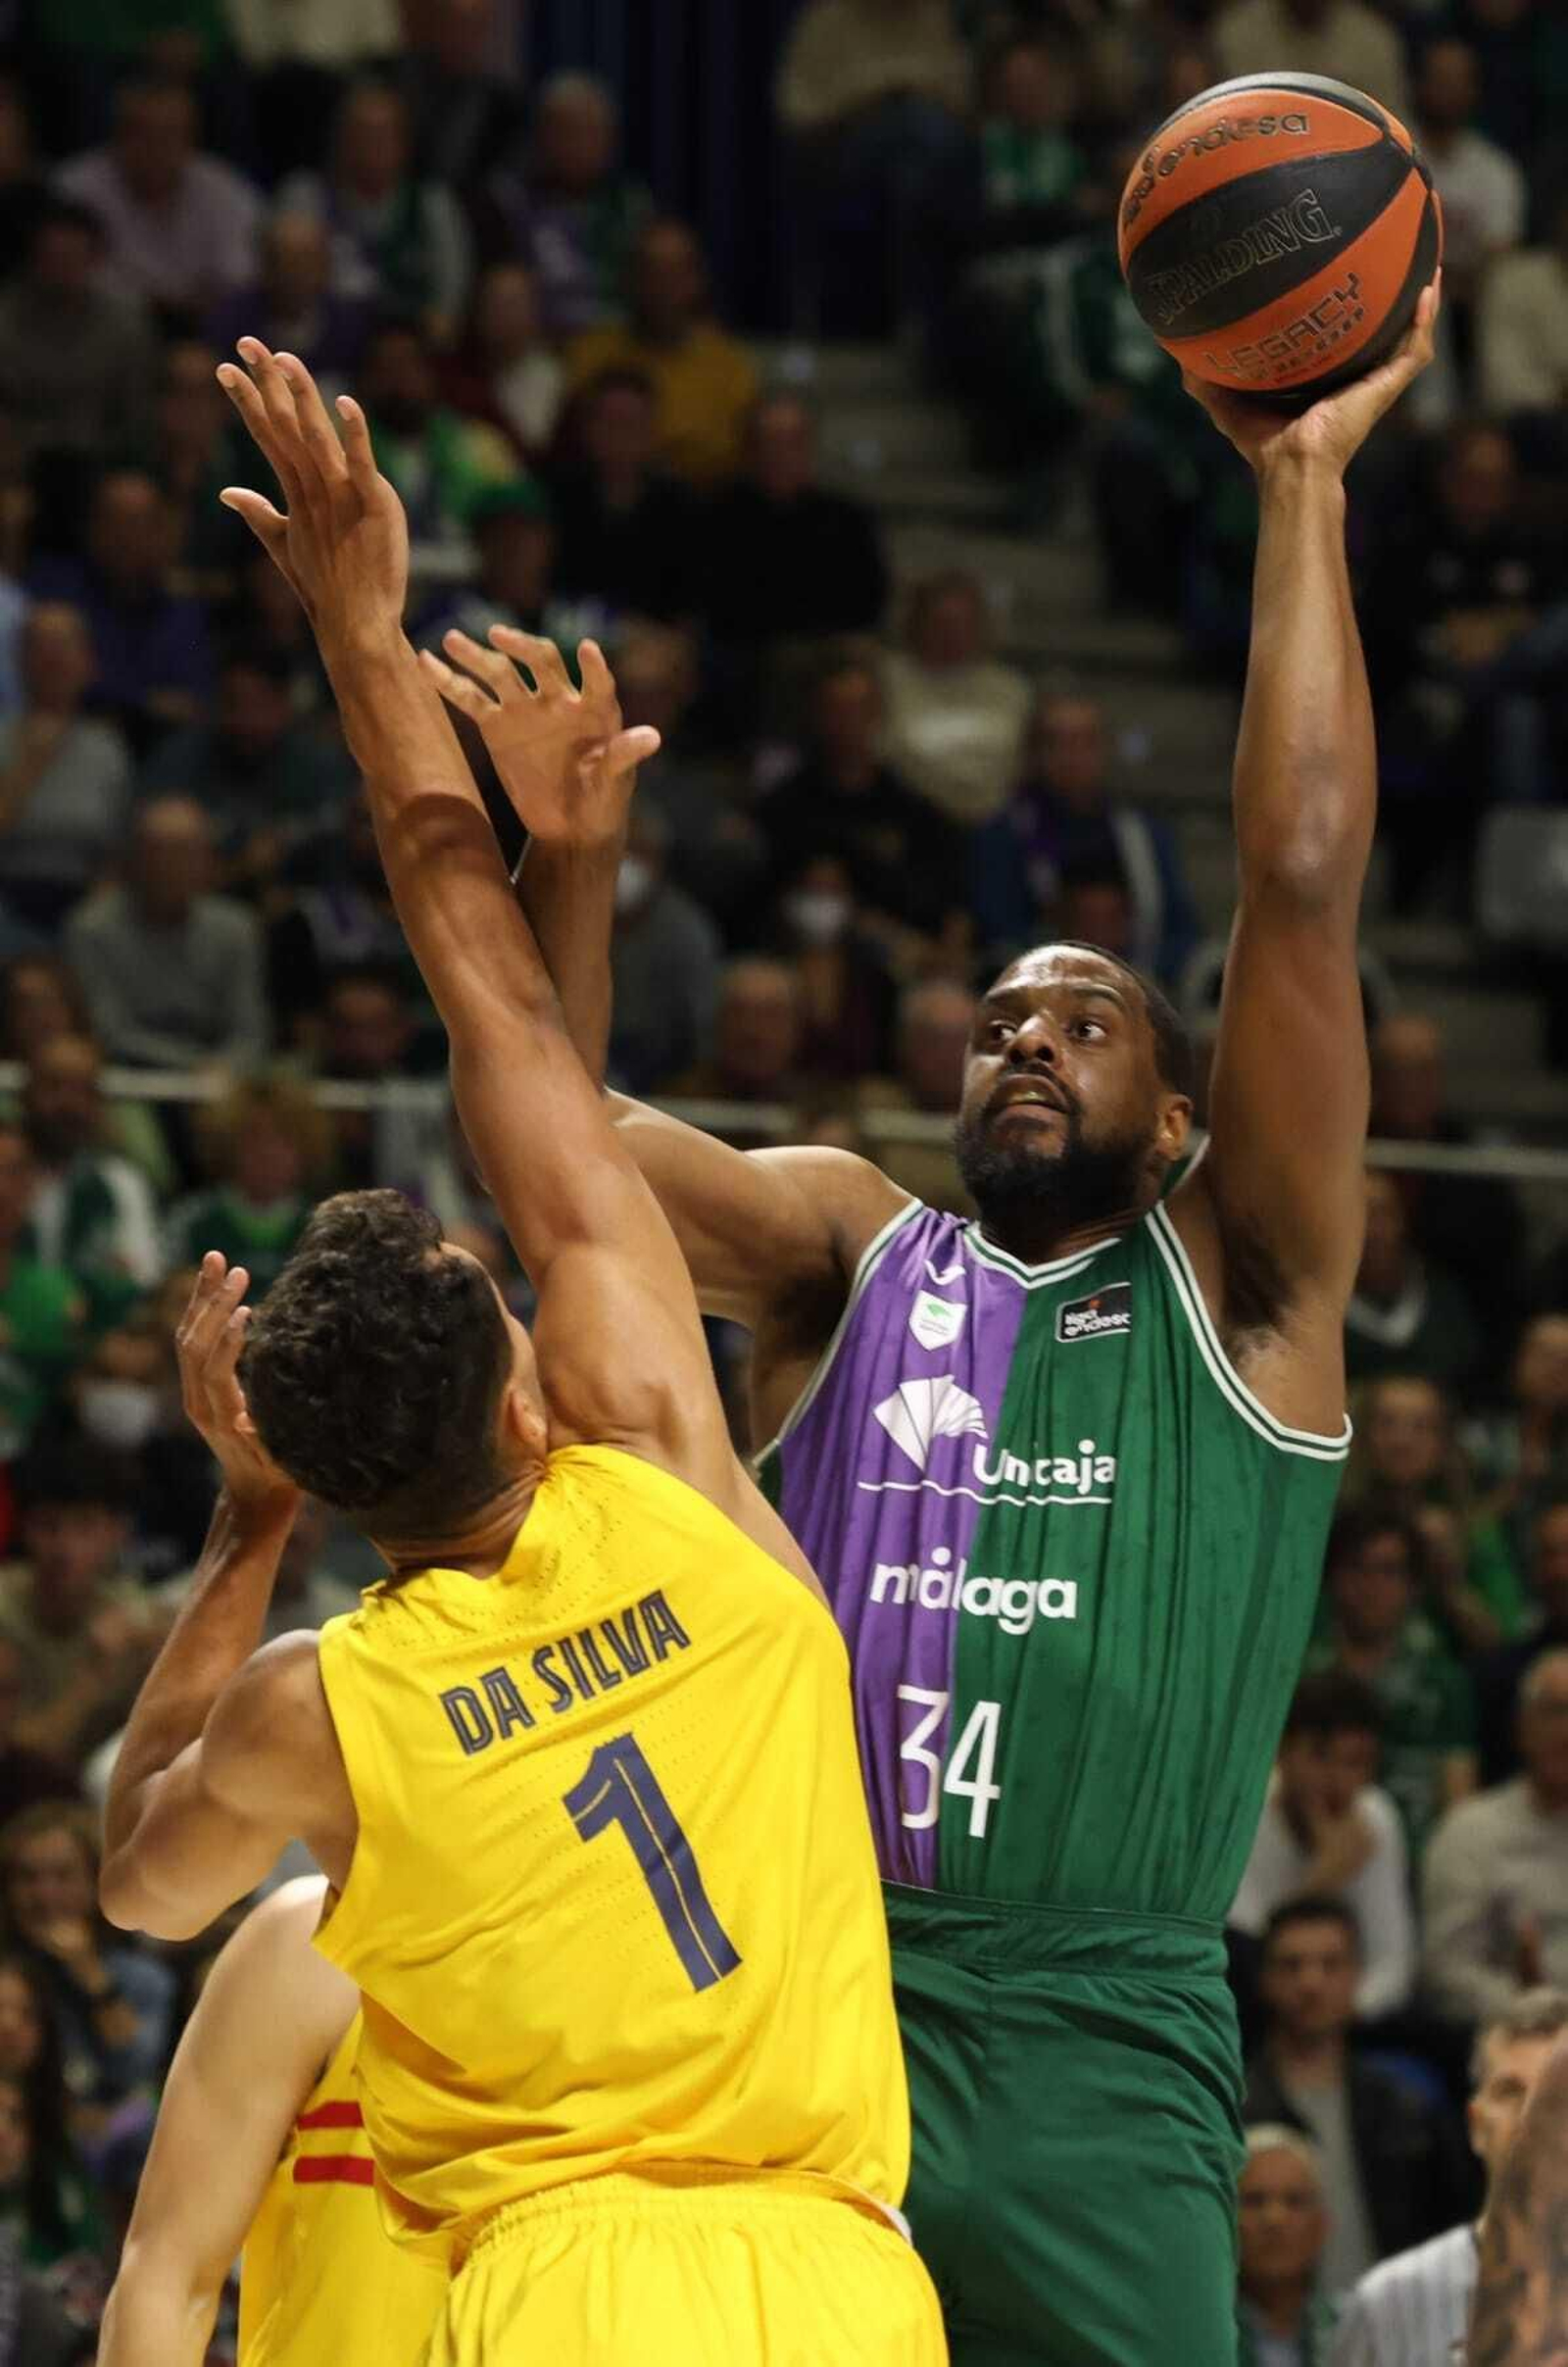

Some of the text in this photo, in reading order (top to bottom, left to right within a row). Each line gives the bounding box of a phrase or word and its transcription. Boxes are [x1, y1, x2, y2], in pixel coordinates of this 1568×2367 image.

[1204, 271, 1360, 372] LEGACY
[973, 1439, 1116, 1495] Uncaja
[438, 1589, 691, 1755] DA SILVA
[898, 1684, 1002, 1838] 34
[562, 1732, 743, 1993] 1
